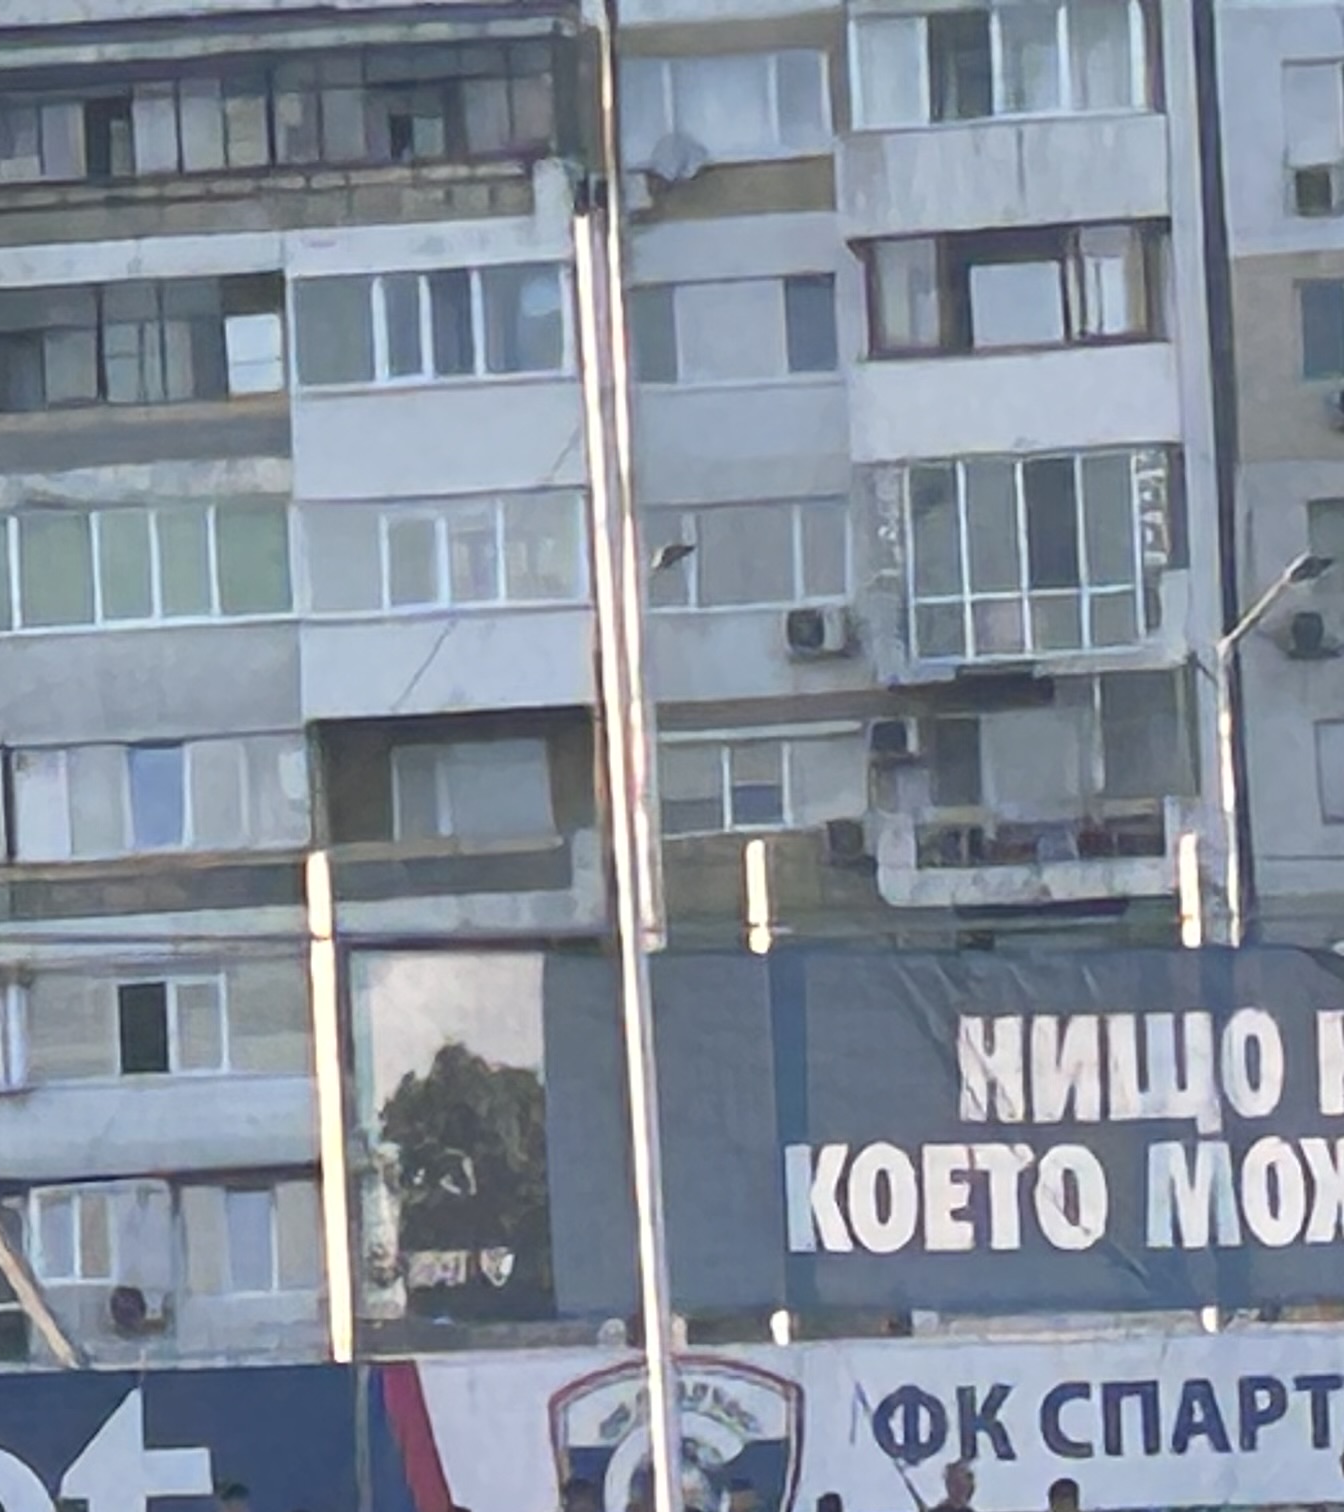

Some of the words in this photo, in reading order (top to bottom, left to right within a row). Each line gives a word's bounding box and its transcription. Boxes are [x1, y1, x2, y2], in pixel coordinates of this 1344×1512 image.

[958, 1007, 1285, 1133] НИЩО
[783, 1141, 1108, 1253] КОЕТО
[870, 1380, 1017, 1463] ФК
